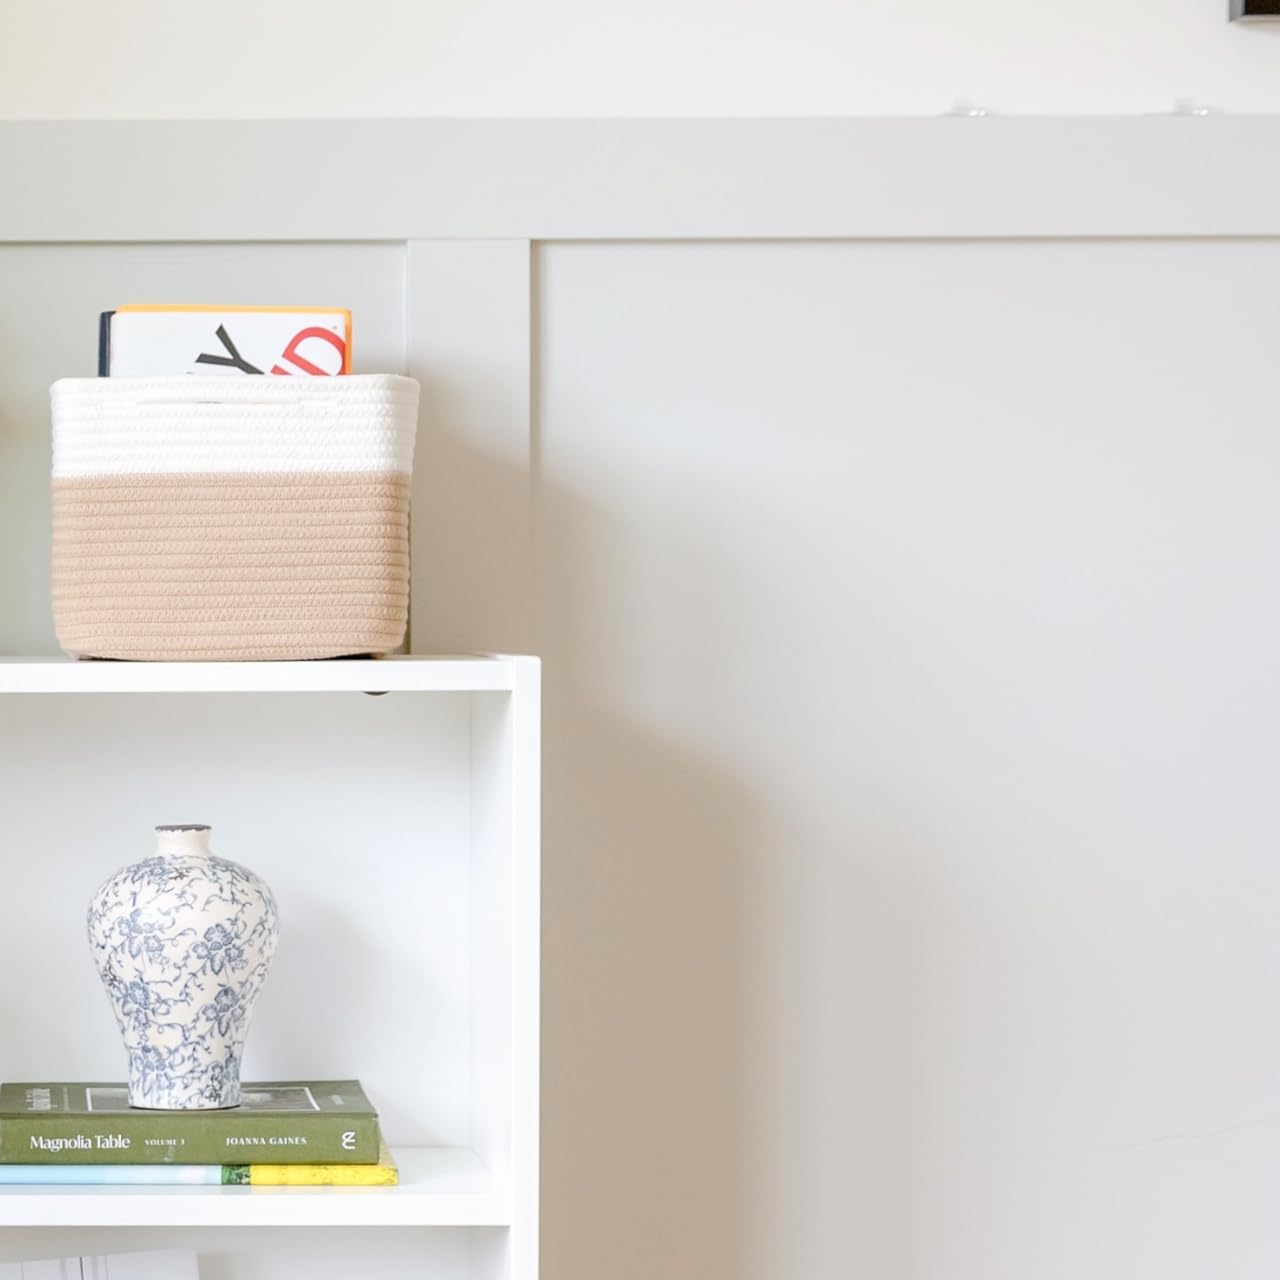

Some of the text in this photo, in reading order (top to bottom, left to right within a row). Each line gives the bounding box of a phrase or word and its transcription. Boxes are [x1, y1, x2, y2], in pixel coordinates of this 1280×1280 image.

[271, 326, 346, 375] D
[30, 1134, 92, 1152] Magnolia
[94, 1134, 131, 1149] Table
[144, 1138, 177, 1146] VOLUME
[226, 1136, 308, 1146] JOANNA GAINES
